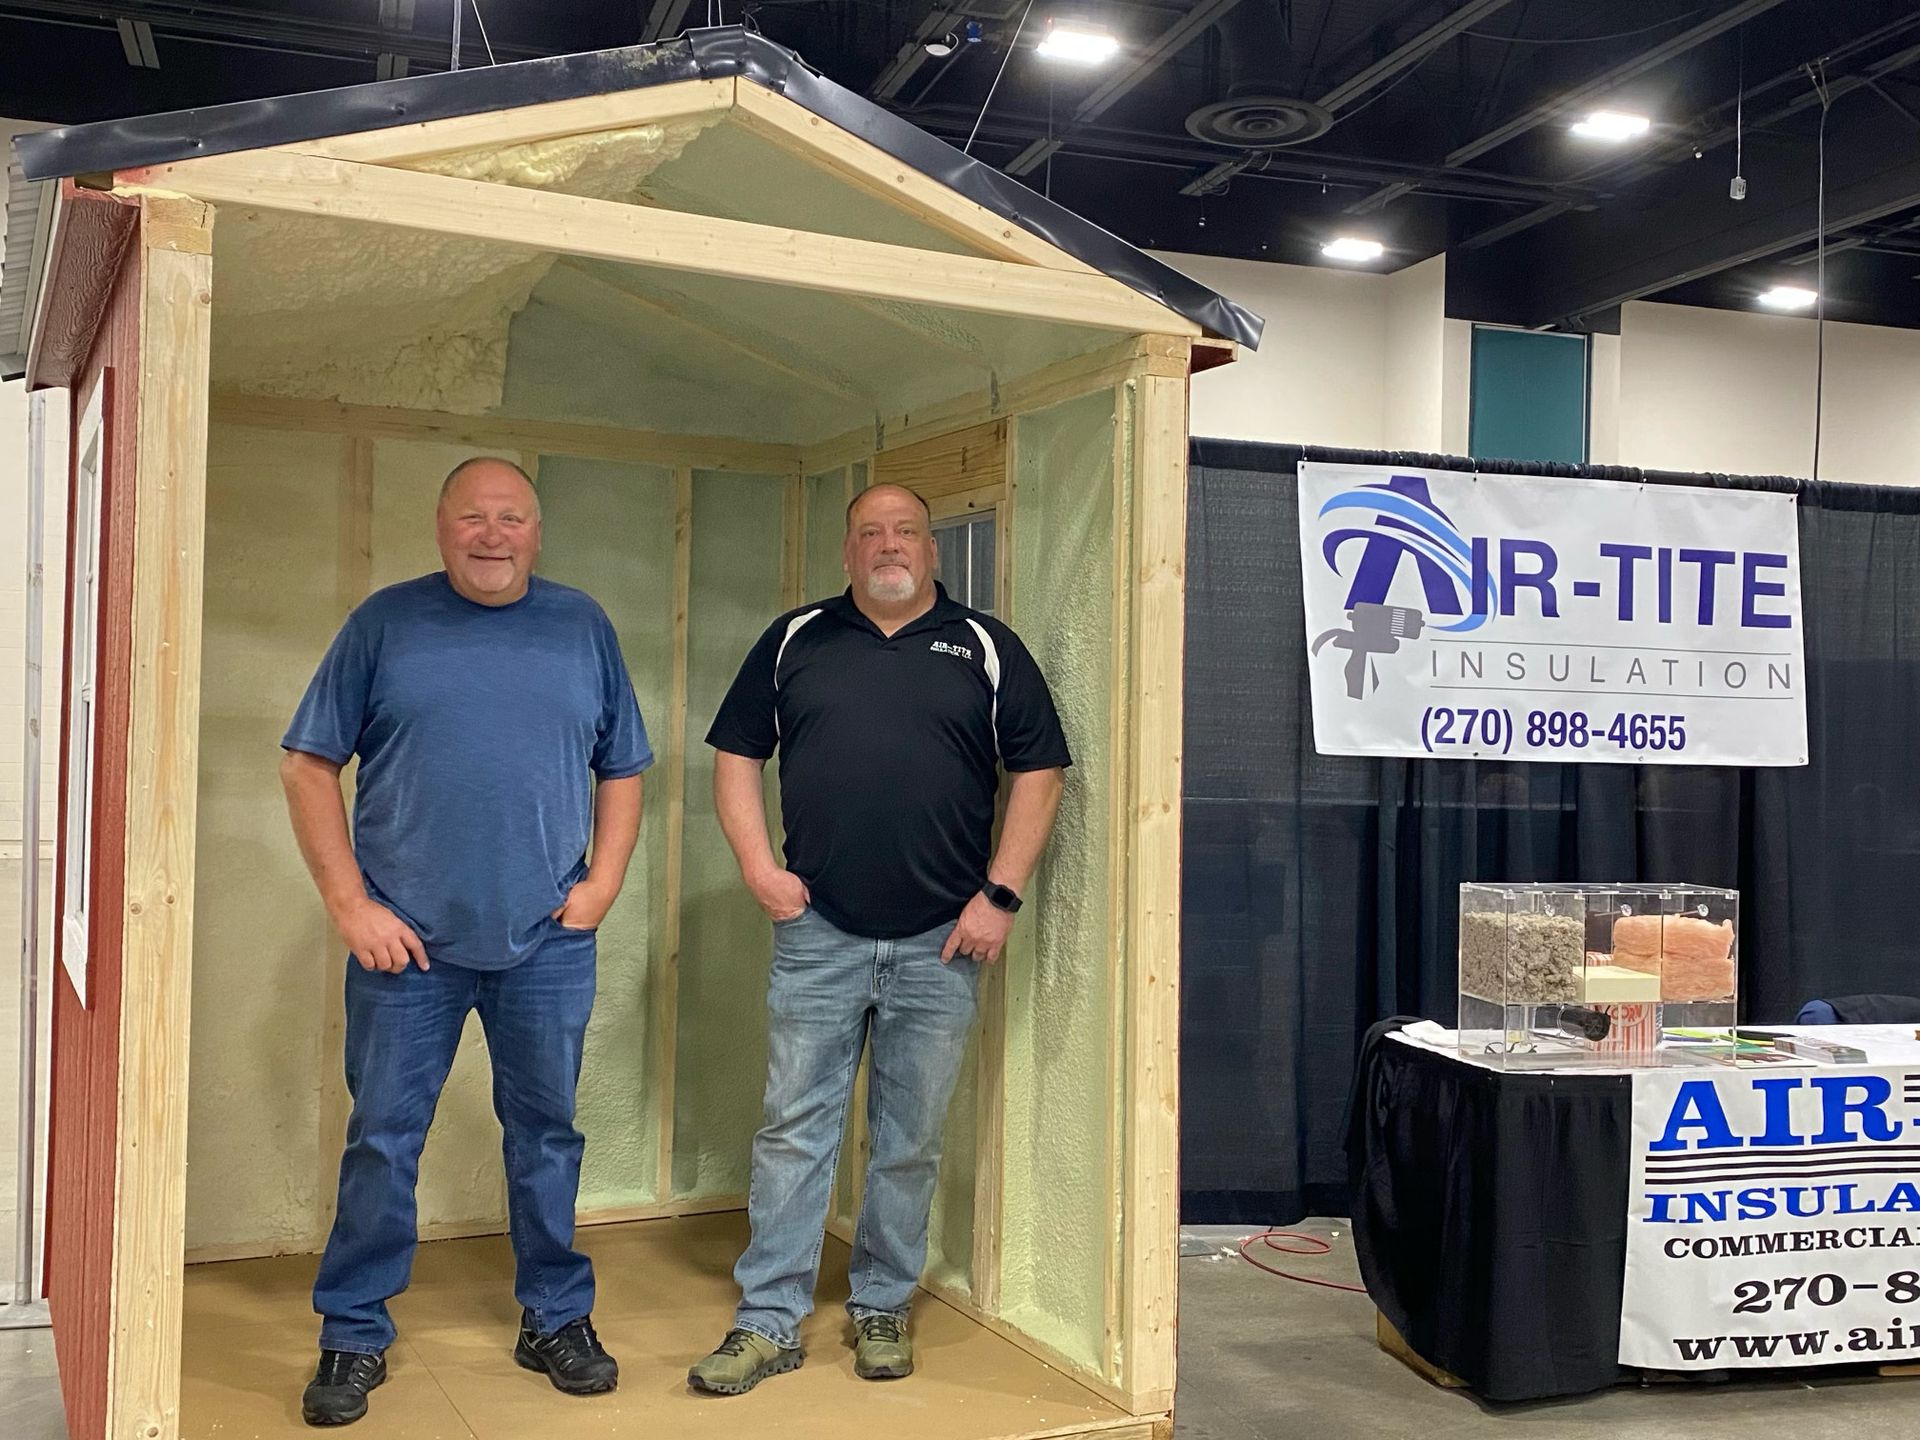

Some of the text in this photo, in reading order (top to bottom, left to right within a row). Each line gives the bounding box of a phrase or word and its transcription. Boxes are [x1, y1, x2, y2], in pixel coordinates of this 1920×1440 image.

[1322, 475, 1793, 629] AIR-TITE
[1432, 649, 1792, 691] INSULATION
[1421, 706, 1687, 754] (270) 898-4655
[1642, 1182, 1920, 1224] INSULA
[1663, 1227, 1920, 1259] COMMERCIA
[1732, 1271, 1920, 1314] 270-8
